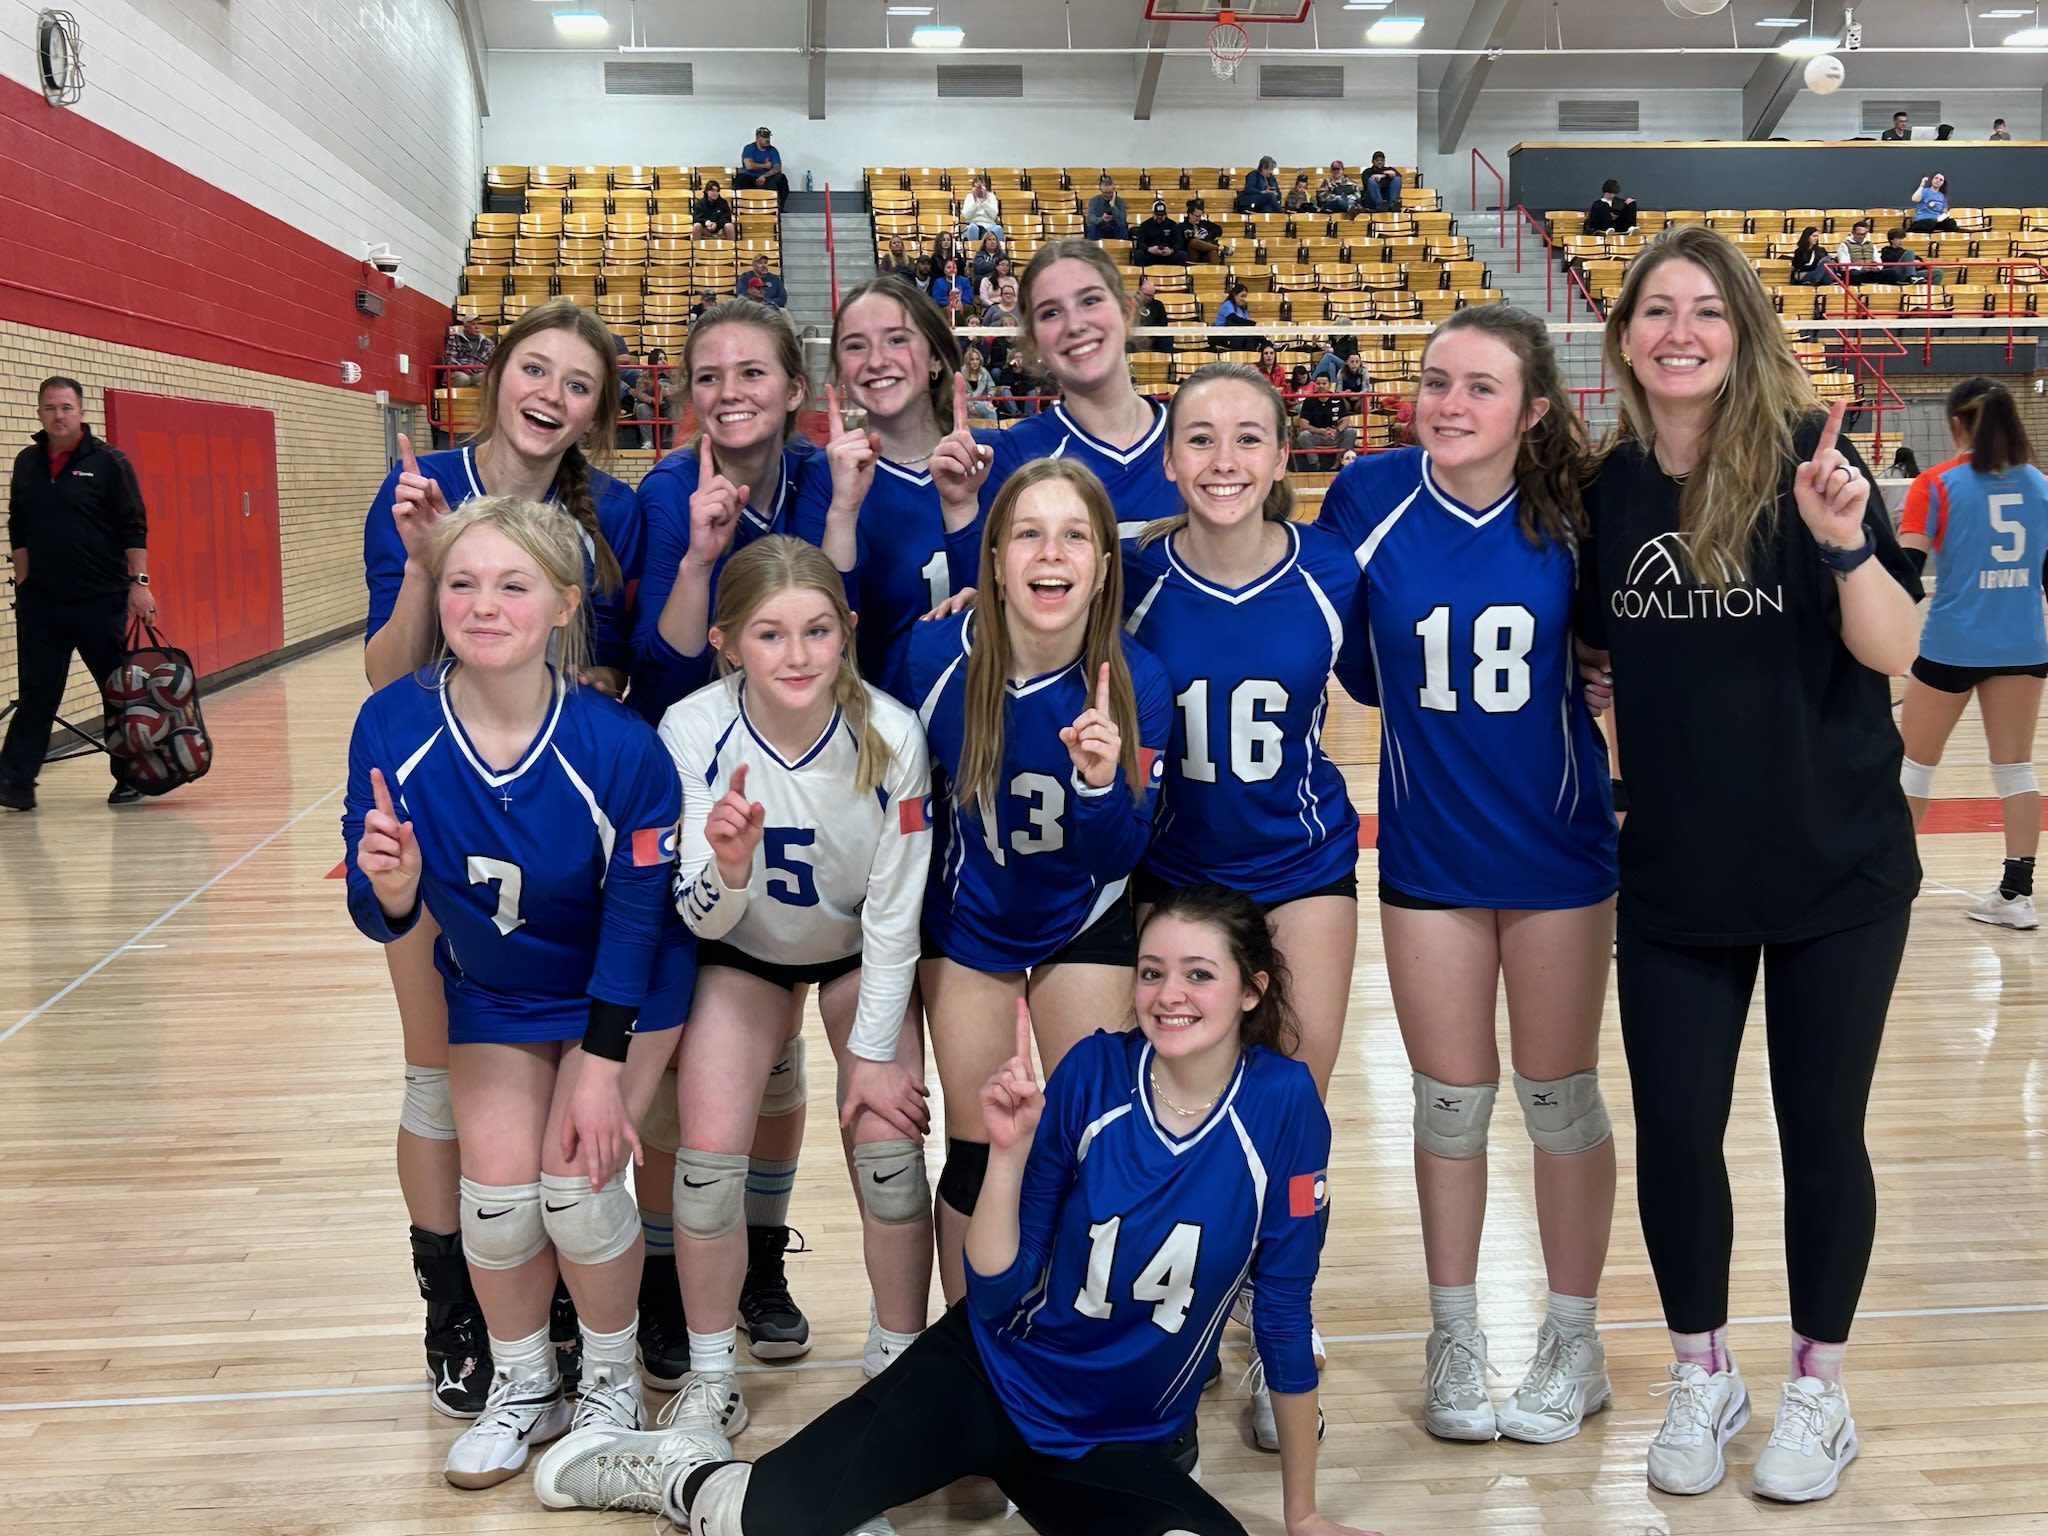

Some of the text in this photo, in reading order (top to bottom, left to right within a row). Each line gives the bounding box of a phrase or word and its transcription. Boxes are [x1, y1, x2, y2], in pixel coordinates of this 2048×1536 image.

[1988, 493, 2026, 563] 5
[1611, 584, 1783, 620] COALITION
[1979, 567, 2030, 589] IRWIN
[1414, 604, 1536, 714] 18
[1175, 678, 1290, 784] 16
[974, 771, 1066, 868] 13
[466, 855, 527, 937] 7
[763, 826, 820, 908] 5
[1073, 1215, 1202, 1334] 14
